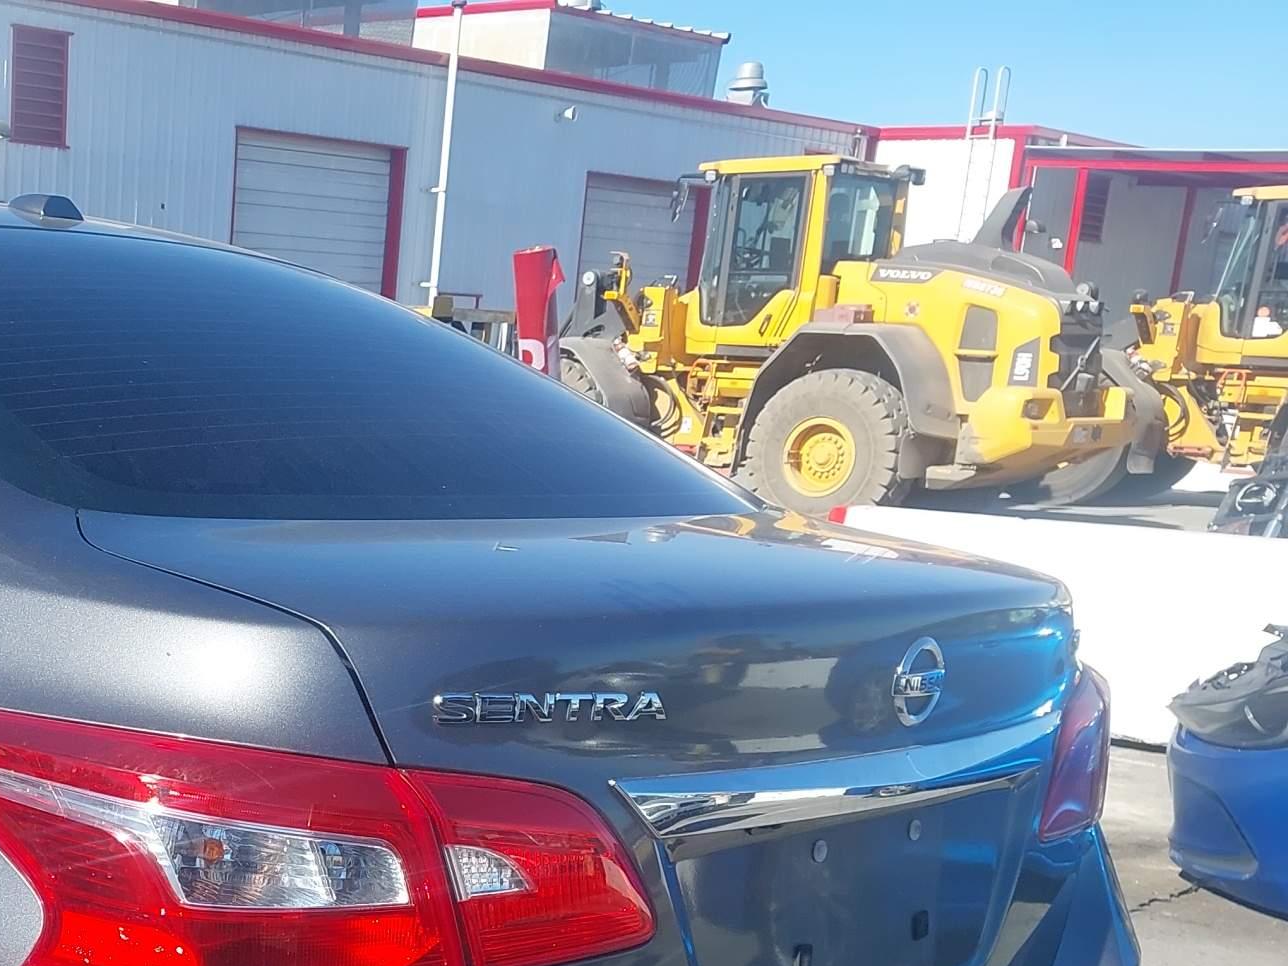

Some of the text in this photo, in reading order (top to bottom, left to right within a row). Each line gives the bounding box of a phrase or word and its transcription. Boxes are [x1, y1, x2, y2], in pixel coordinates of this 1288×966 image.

[878, 268, 933, 280] VOLVO
[903, 673, 943, 692] NISS
[432, 692, 668, 724] SENTRA
